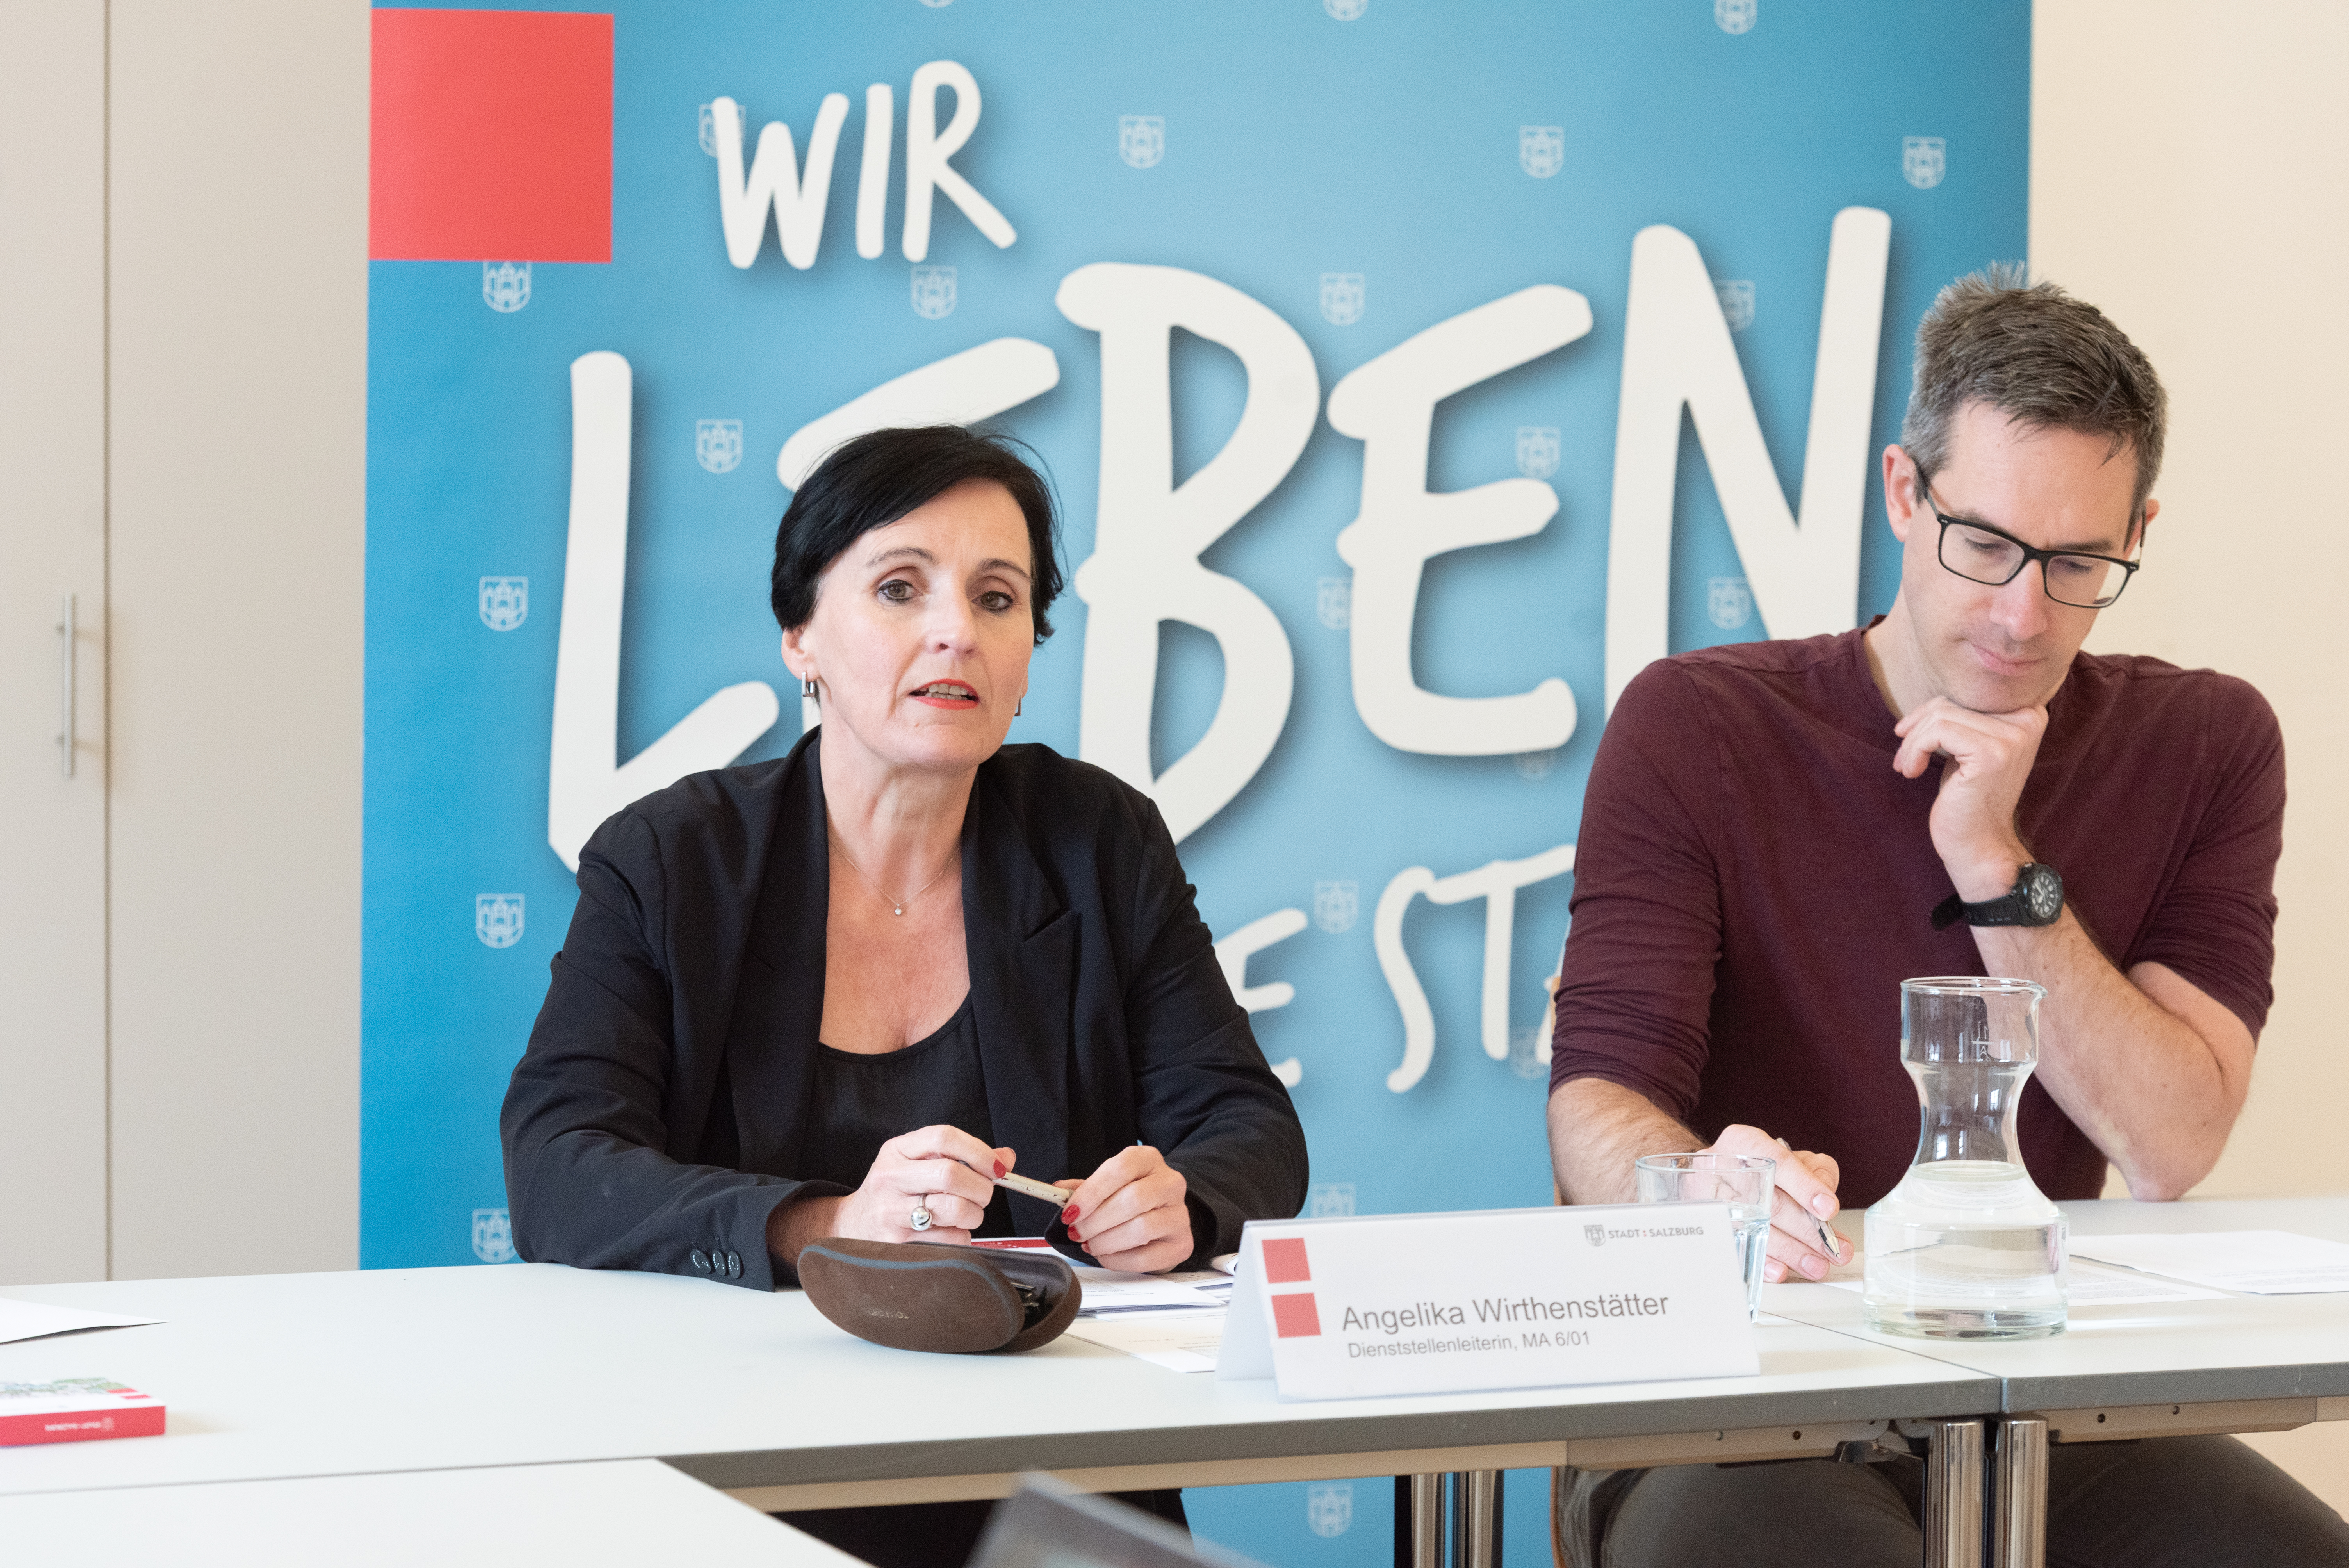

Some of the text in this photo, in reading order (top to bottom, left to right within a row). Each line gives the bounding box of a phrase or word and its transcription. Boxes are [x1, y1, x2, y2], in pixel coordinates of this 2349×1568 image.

[710, 59, 1018, 270] WIR
[1373, 843, 1576, 1093] ST
[1608, 1229, 1640, 1239] STADT
[1649, 1226, 1705, 1237] SALZBURG
[1342, 1293, 1669, 1335] Angelika Wirthenstätter
[1348, 1331, 1590, 1358] Dienststellenleiterin, MA 6/01
